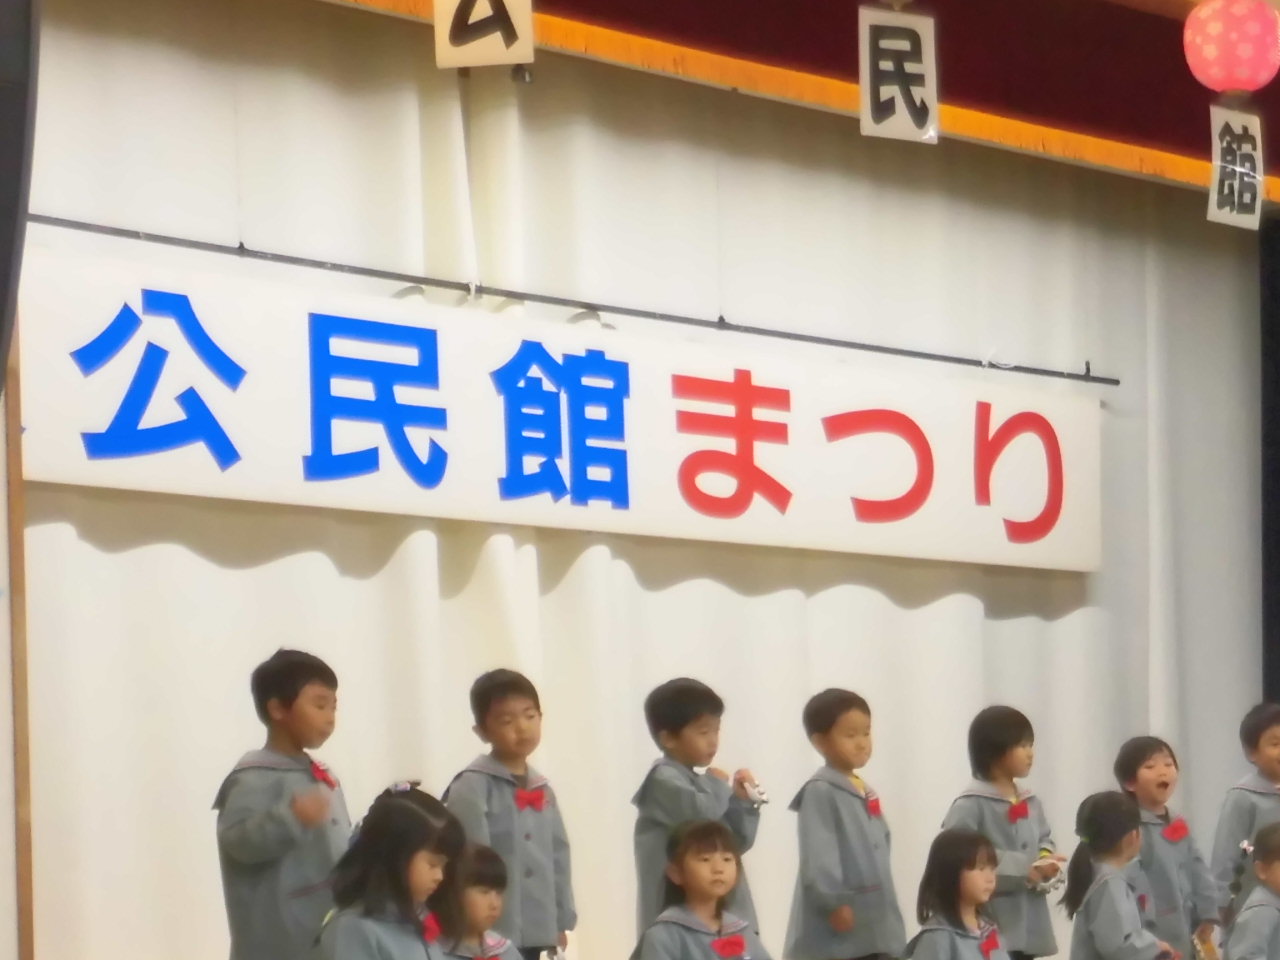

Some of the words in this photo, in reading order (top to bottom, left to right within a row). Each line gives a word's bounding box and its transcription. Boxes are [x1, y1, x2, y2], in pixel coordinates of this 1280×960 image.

[869, 24, 930, 130] 民
[1216, 121, 1257, 214] 館
[69, 288, 1064, 545] 公民館まつり
